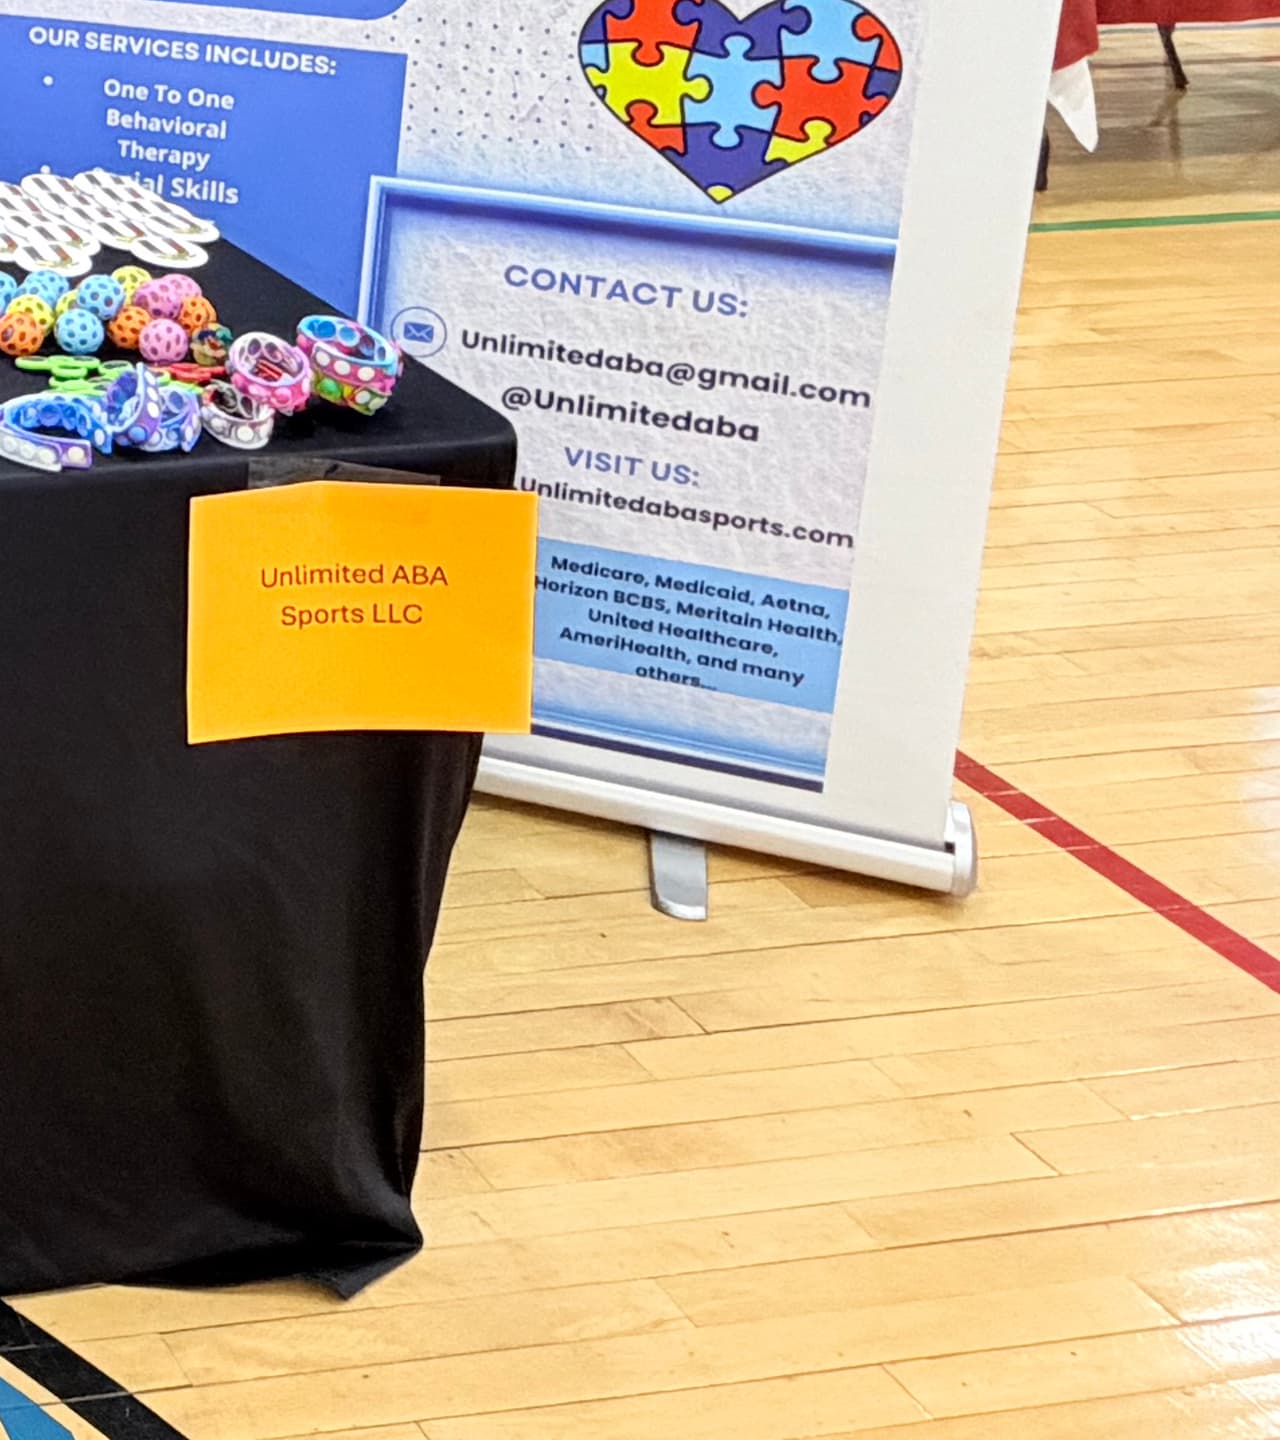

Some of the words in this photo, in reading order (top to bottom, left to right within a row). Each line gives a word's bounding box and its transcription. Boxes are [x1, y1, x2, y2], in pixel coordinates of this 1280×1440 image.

[29, 26, 79, 49] OUR
[84, 30, 200, 62] SERVICES
[205, 43, 337, 76] INCLUDES:
[103, 78, 148, 102] One
[154, 83, 181, 104] To
[187, 87, 235, 110] One
[106, 108, 227, 140] Behavioral
[117, 139, 210, 172] Therapy
[170, 176, 240, 206] Skills
[504, 264, 682, 310] CONTACT
[692, 290, 749, 318] US:
[461, 329, 871, 409] Unlimitedaba@gmail.com
[501, 386, 760, 443] @Unlimitedaba
[564, 446, 644, 477] VISIT
[652, 461, 700, 487] US:
[519, 476, 855, 549] Unlimitedabasports.com
[261, 564, 384, 588] Unlimited
[391, 565, 448, 586] ABA
[551, 556, 650, 588] Medicare,
[655, 573, 755, 605] Medicaid,
[760, 592, 831, 619] Aetna,
[281, 605, 364, 630] Sports
[372, 604, 423, 624] LLC
[535, 575, 609, 604] Horizon
[613, 592, 672, 615] BCBS,
[676, 601, 762, 631] Meritain
[767, 619, 842, 647] Health,
[588, 608, 654, 633] United
[659, 621, 778, 658] Healthcare,
[559, 627, 691, 665] AmeriHealth,
[697, 651, 737, 671] and
[742, 663, 805, 688] many
